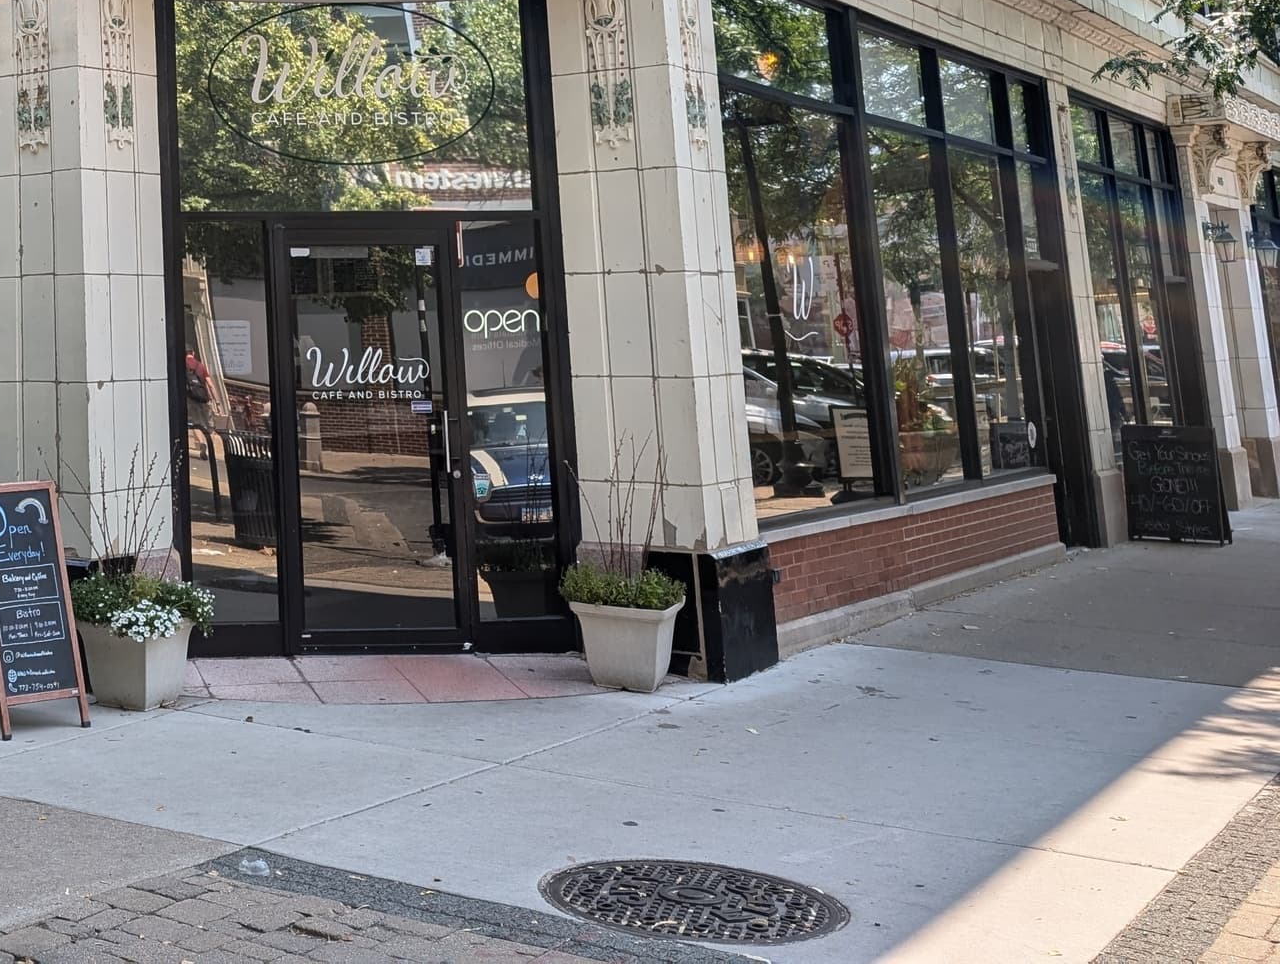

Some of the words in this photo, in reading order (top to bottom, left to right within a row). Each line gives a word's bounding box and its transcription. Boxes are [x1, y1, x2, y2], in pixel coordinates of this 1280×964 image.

[240, 34, 468, 104] Willow
[319, 112, 363, 126] AND
[375, 112, 453, 126] BISTRO
[464, 310, 540, 339] open
[306, 346, 430, 387] Willow
[348, 391, 373, 399] AND
[378, 390, 422, 399] BISTRO
[16, 607, 41, 619] Bistro
